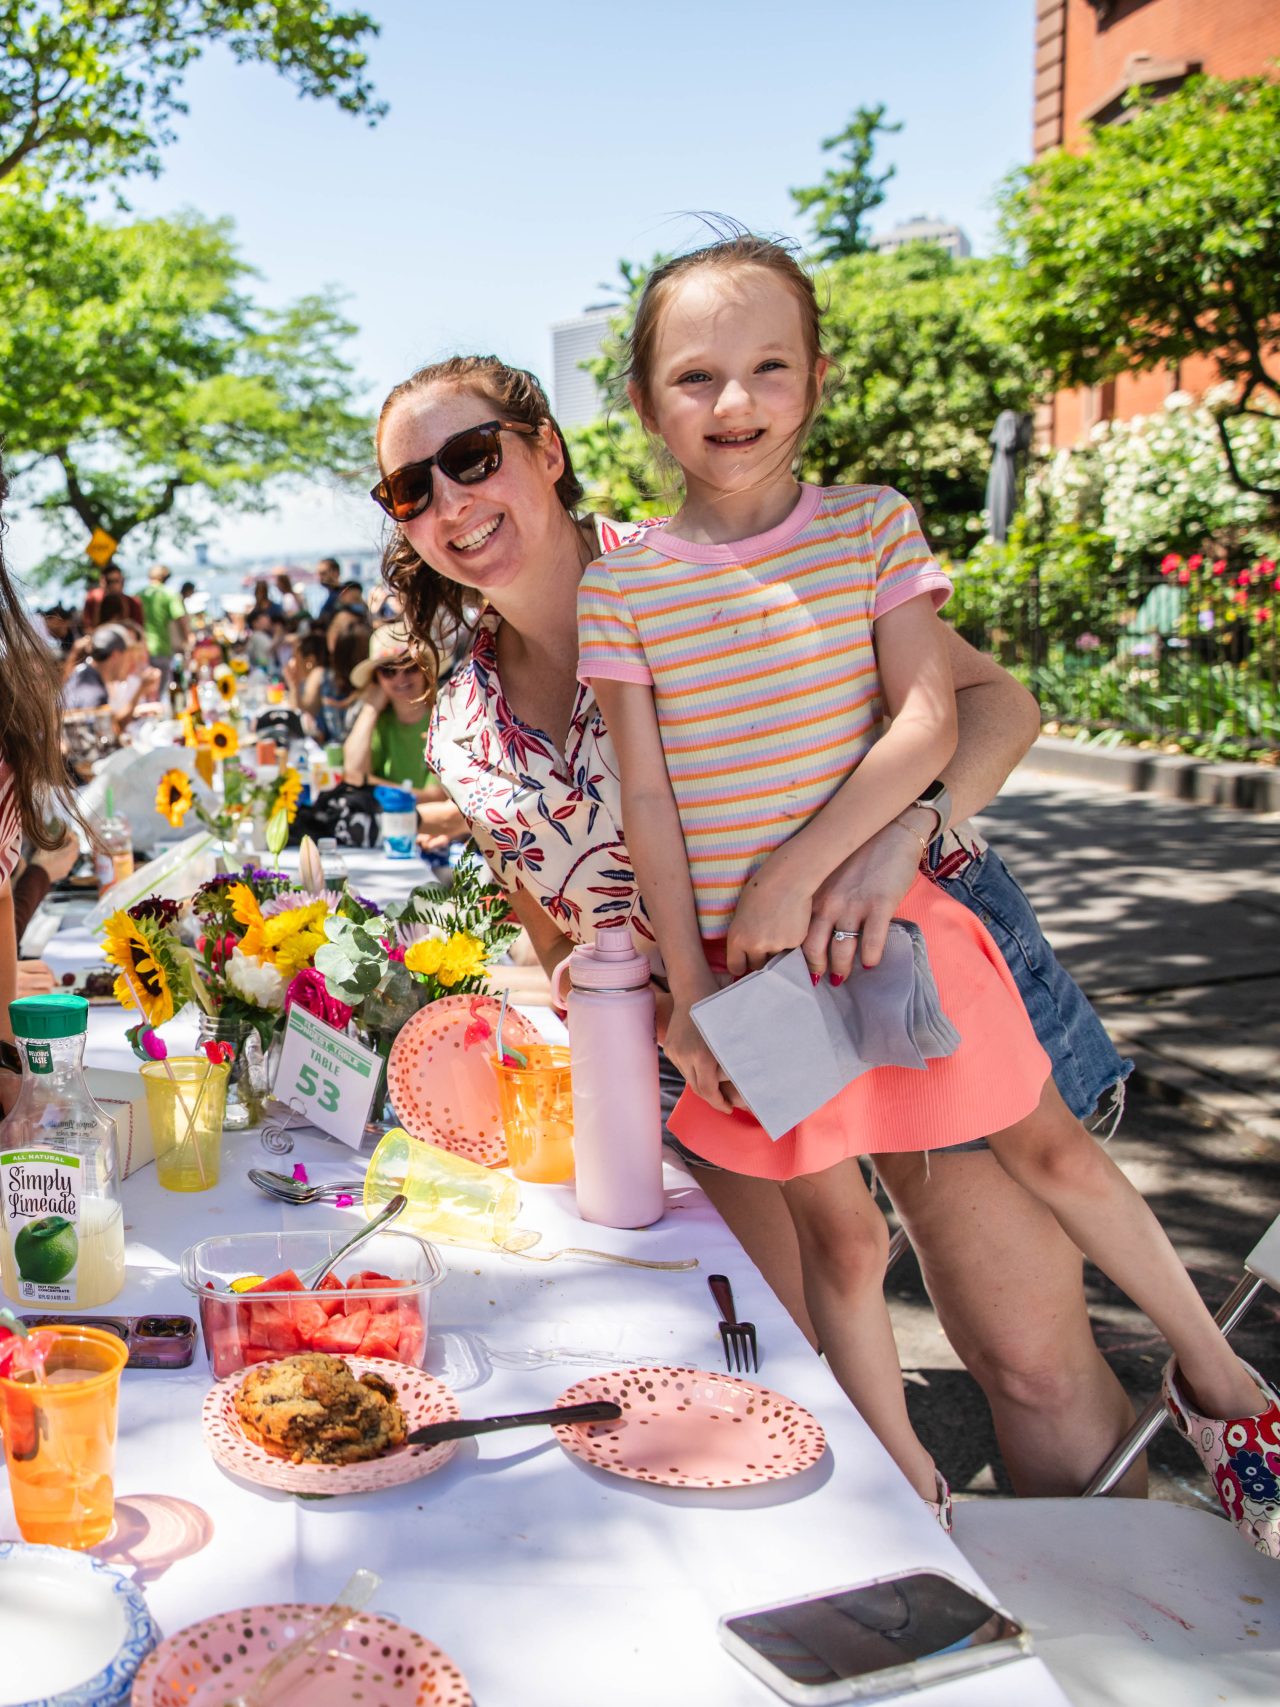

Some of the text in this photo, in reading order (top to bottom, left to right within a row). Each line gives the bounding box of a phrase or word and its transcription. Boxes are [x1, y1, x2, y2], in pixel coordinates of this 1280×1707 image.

[32, 1056, 48, 1064] TASTE
[310, 1047, 341, 1077] TABLE
[295, 1063, 341, 1113] 53
[28, 1154, 65, 1163] NATURAL
[8, 1165, 76, 1198] Simply
[8, 1192, 77, 1219] Limeade
